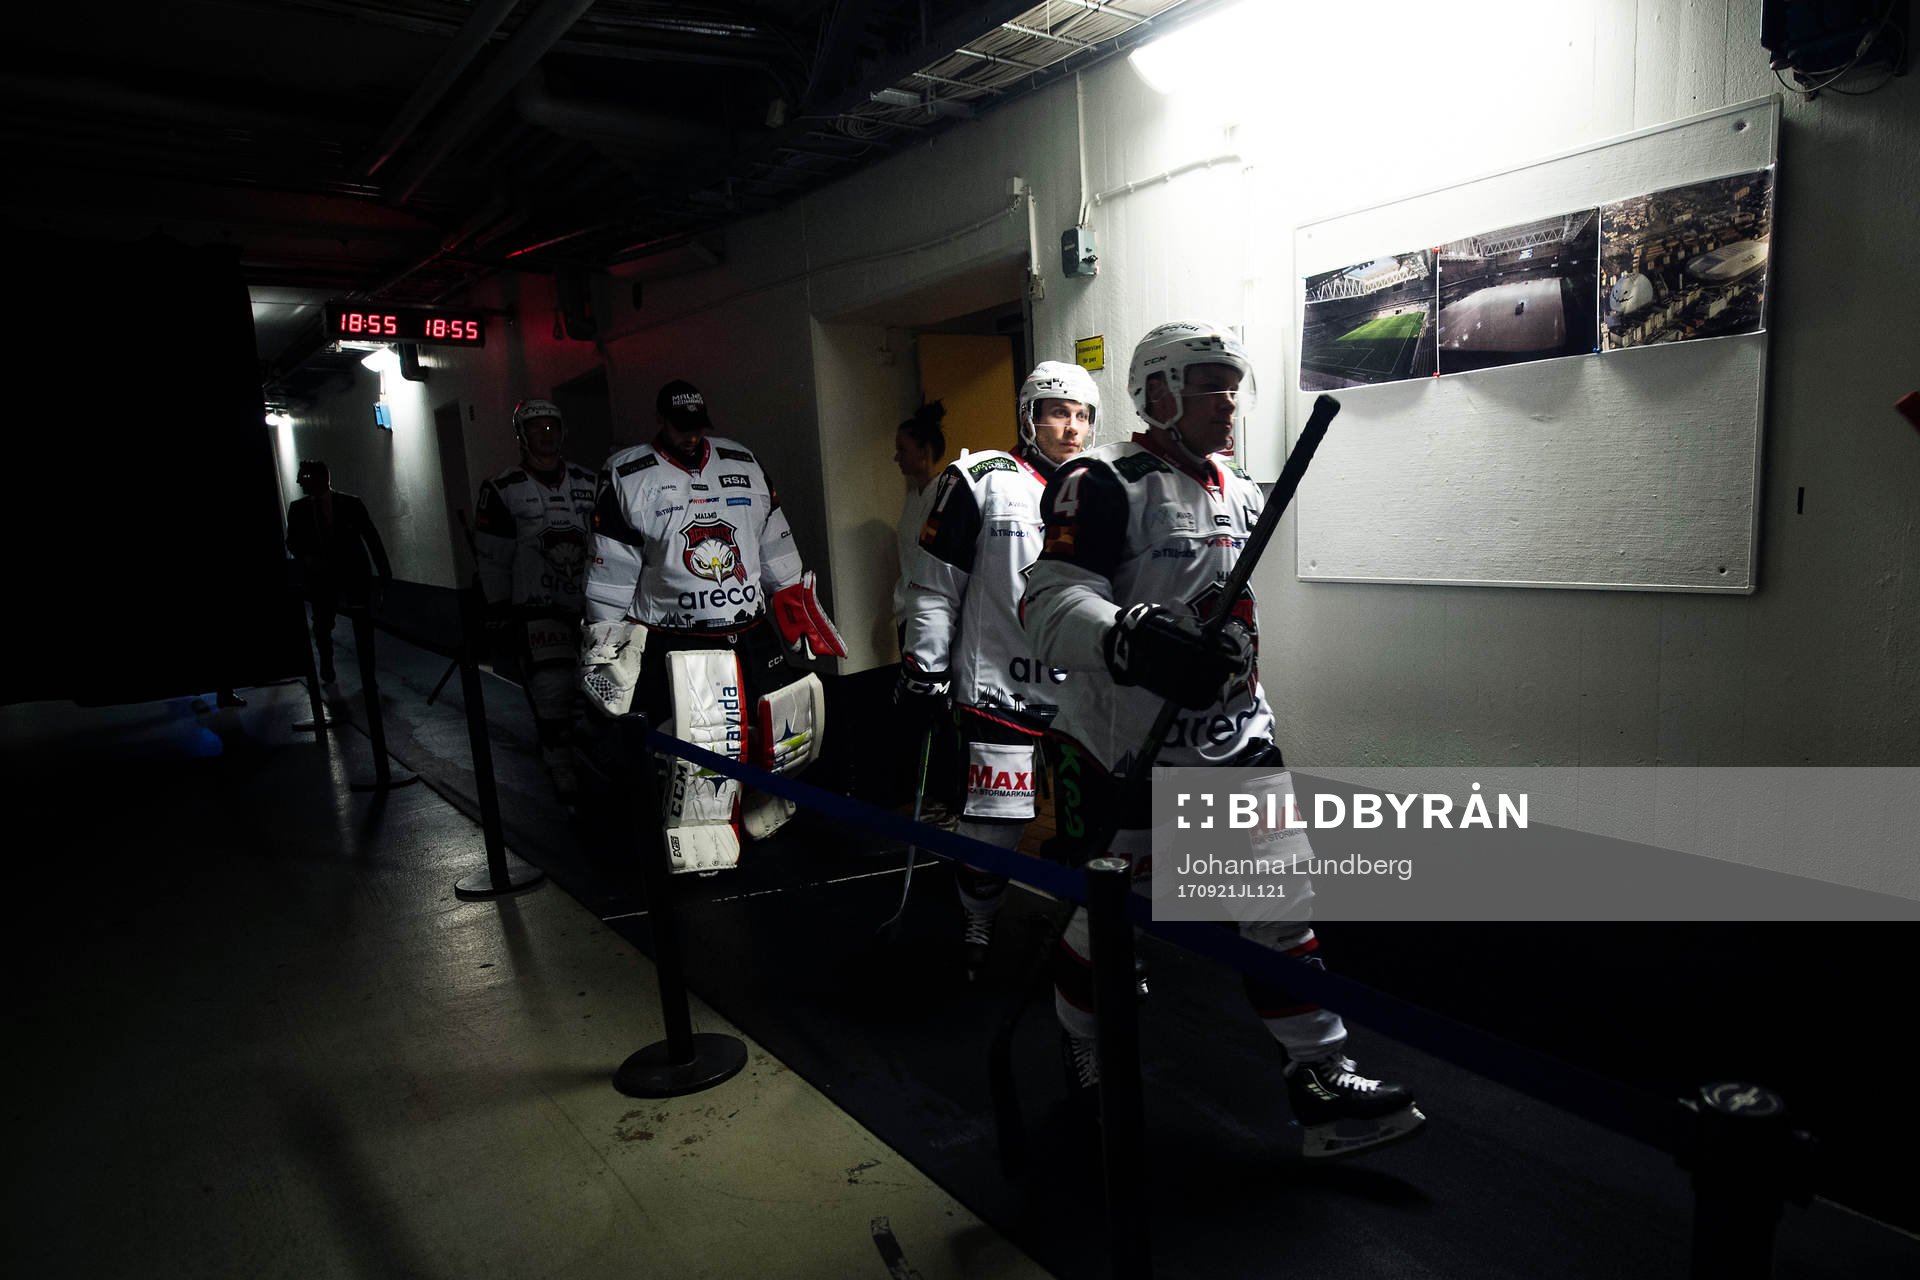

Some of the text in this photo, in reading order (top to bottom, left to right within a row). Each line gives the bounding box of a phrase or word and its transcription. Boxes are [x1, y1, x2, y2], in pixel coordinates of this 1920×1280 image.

[340, 312, 397, 335] 18:55
[425, 318, 478, 340] 18:55
[723, 475, 748, 486] RSA
[1053, 466, 1090, 518] 4
[678, 585, 756, 610] areco
[717, 686, 741, 757] ravida
[671, 765, 688, 818] CCM
